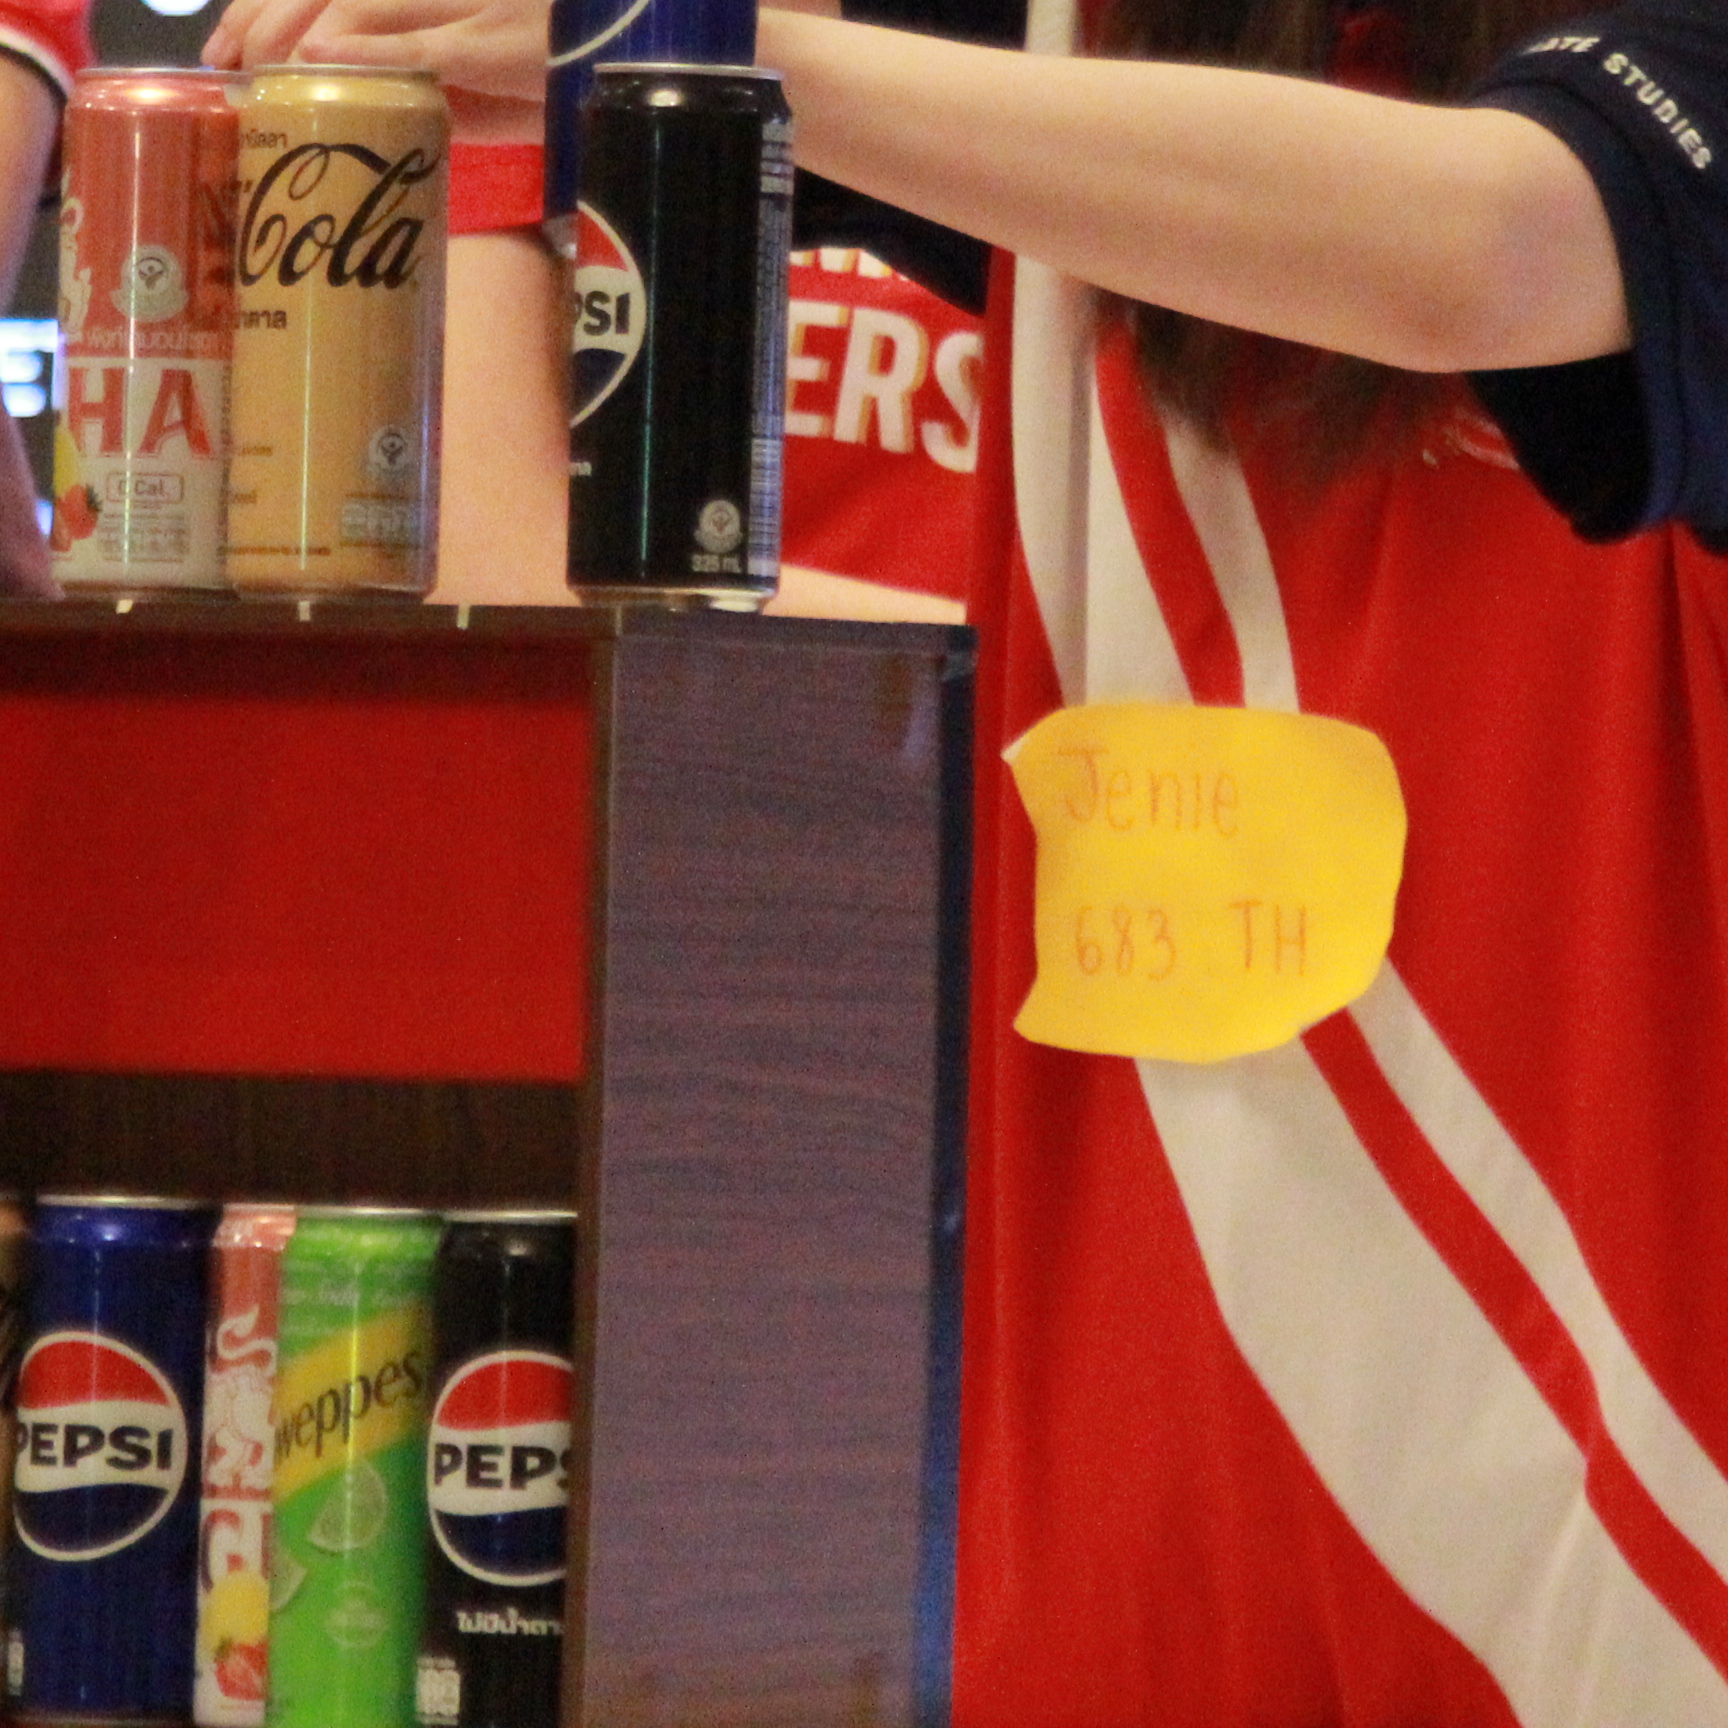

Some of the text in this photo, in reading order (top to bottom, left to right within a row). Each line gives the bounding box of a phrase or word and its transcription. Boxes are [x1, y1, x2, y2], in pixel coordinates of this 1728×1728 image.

[1603, 52, 1713, 170] STUDIES
[68, 366, 218, 456] HA
[783, 298, 985, 475] ERS
[1075, 897, 1308, 982] 683 TH
[274, 1350, 422, 1467] weppes
